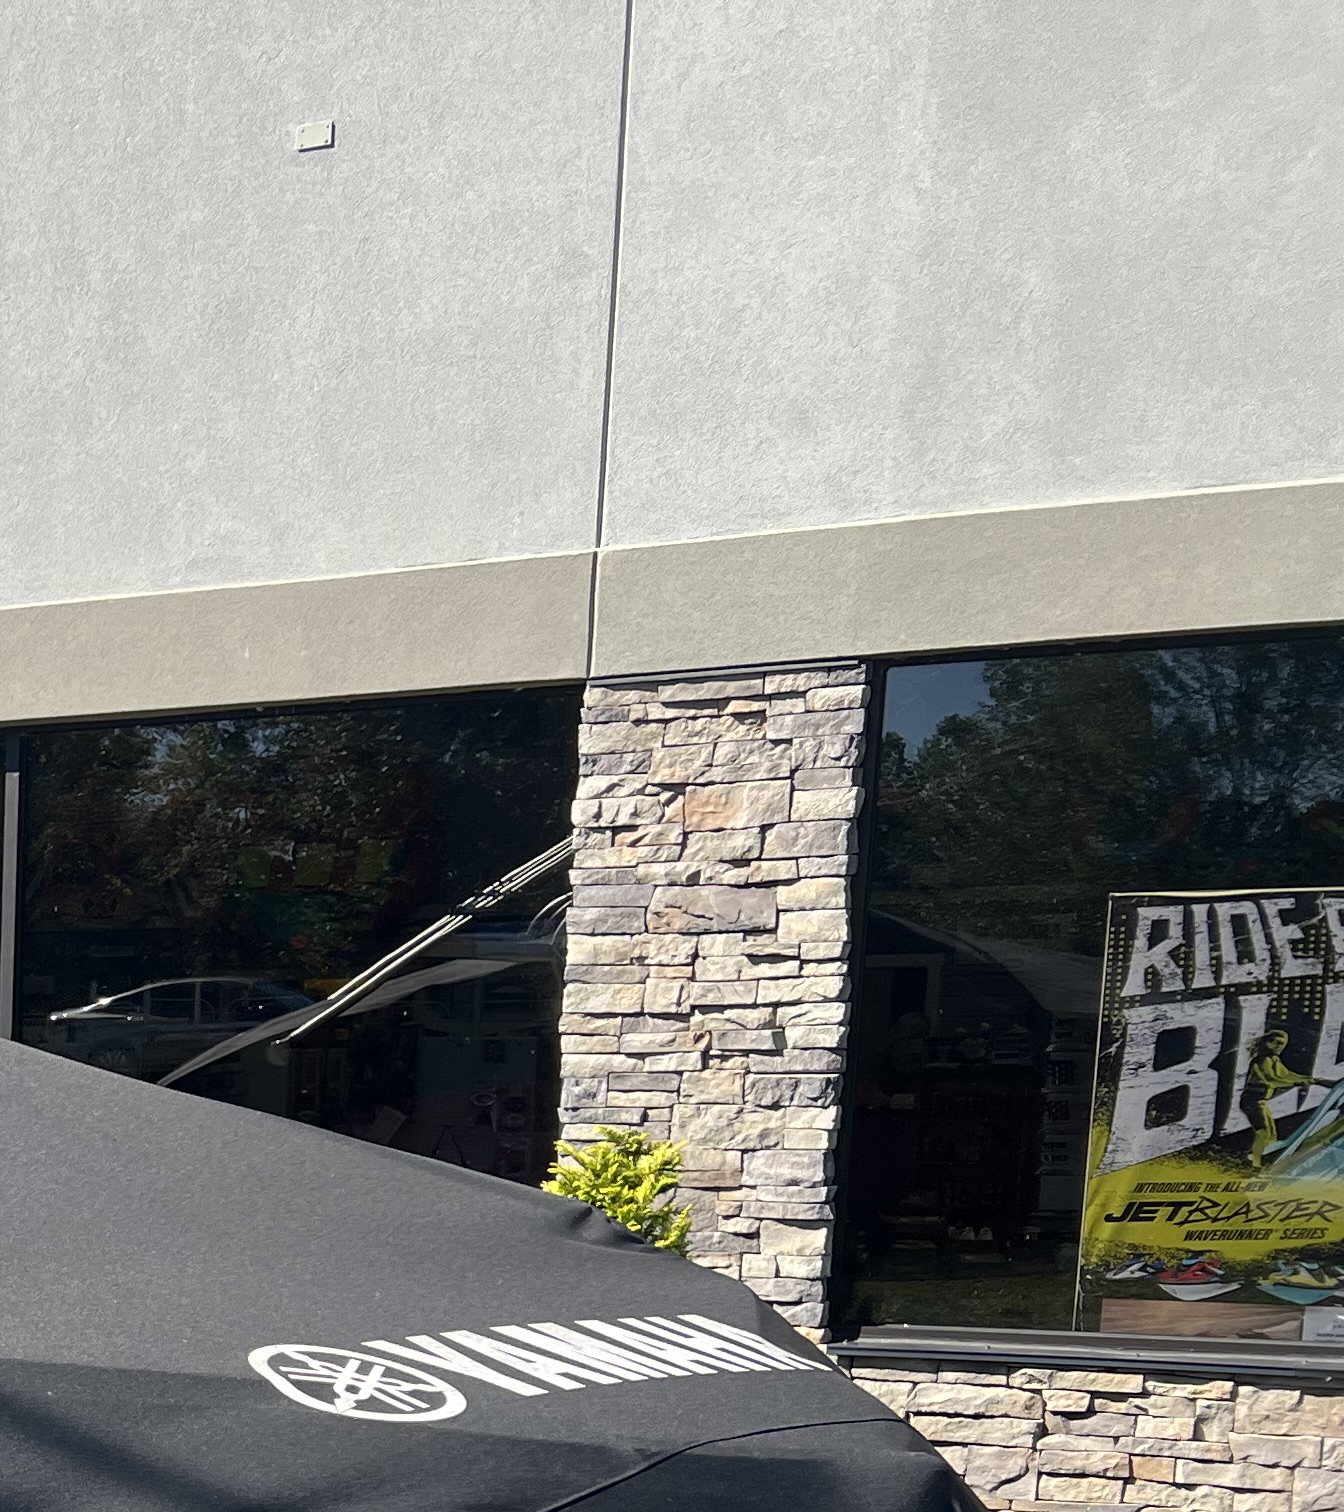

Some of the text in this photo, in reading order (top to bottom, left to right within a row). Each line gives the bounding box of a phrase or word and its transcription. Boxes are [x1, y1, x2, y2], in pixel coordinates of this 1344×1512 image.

[1133, 1181, 1270, 1193] INTRODUCING THE ALL-NEW
[1280, 1226, 1329, 1240] SERIES
[361, 1314, 834, 1397] YAMAHA
